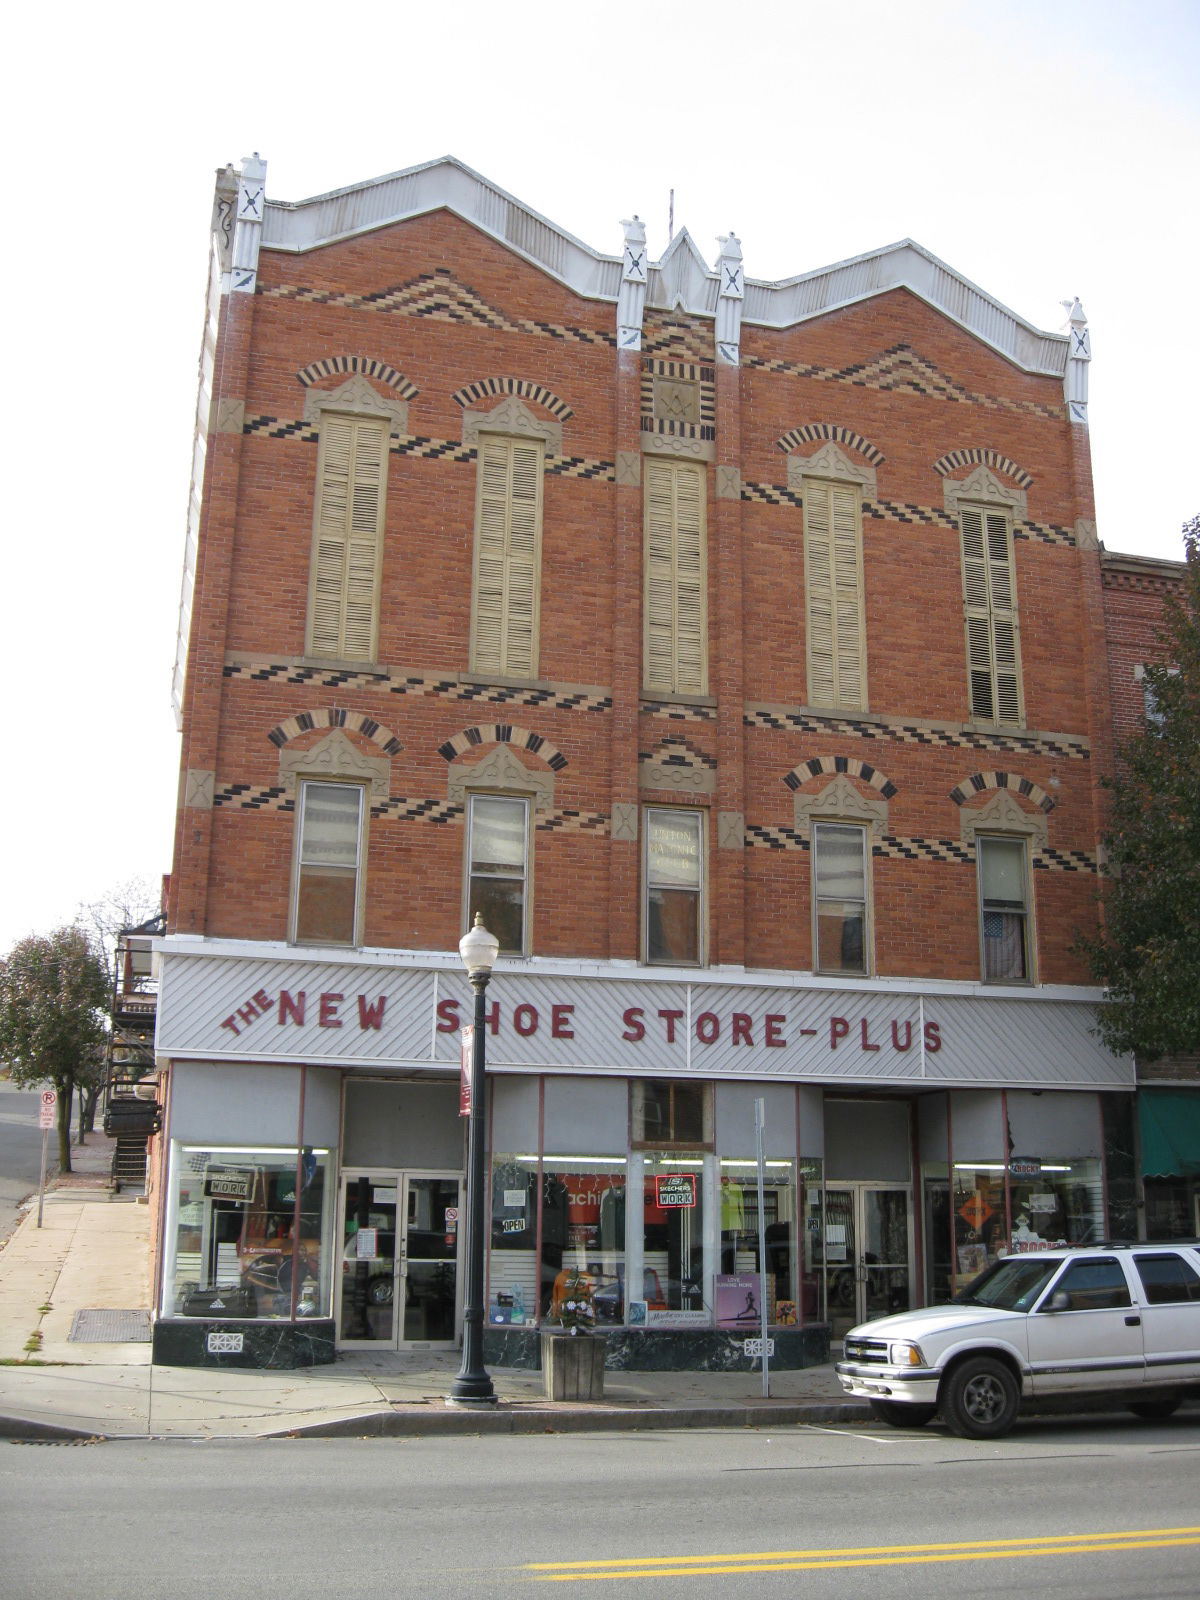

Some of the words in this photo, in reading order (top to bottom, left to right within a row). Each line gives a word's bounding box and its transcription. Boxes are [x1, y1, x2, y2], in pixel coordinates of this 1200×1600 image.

[220, 988, 275, 1036] THE
[278, 990, 387, 1031] NEW
[436, 999, 575, 1039] SHOE
[211, 1181, 247, 1195] WORK
[661, 1193, 691, 1204] WORK
[504, 1219, 524, 1232] OPEN
